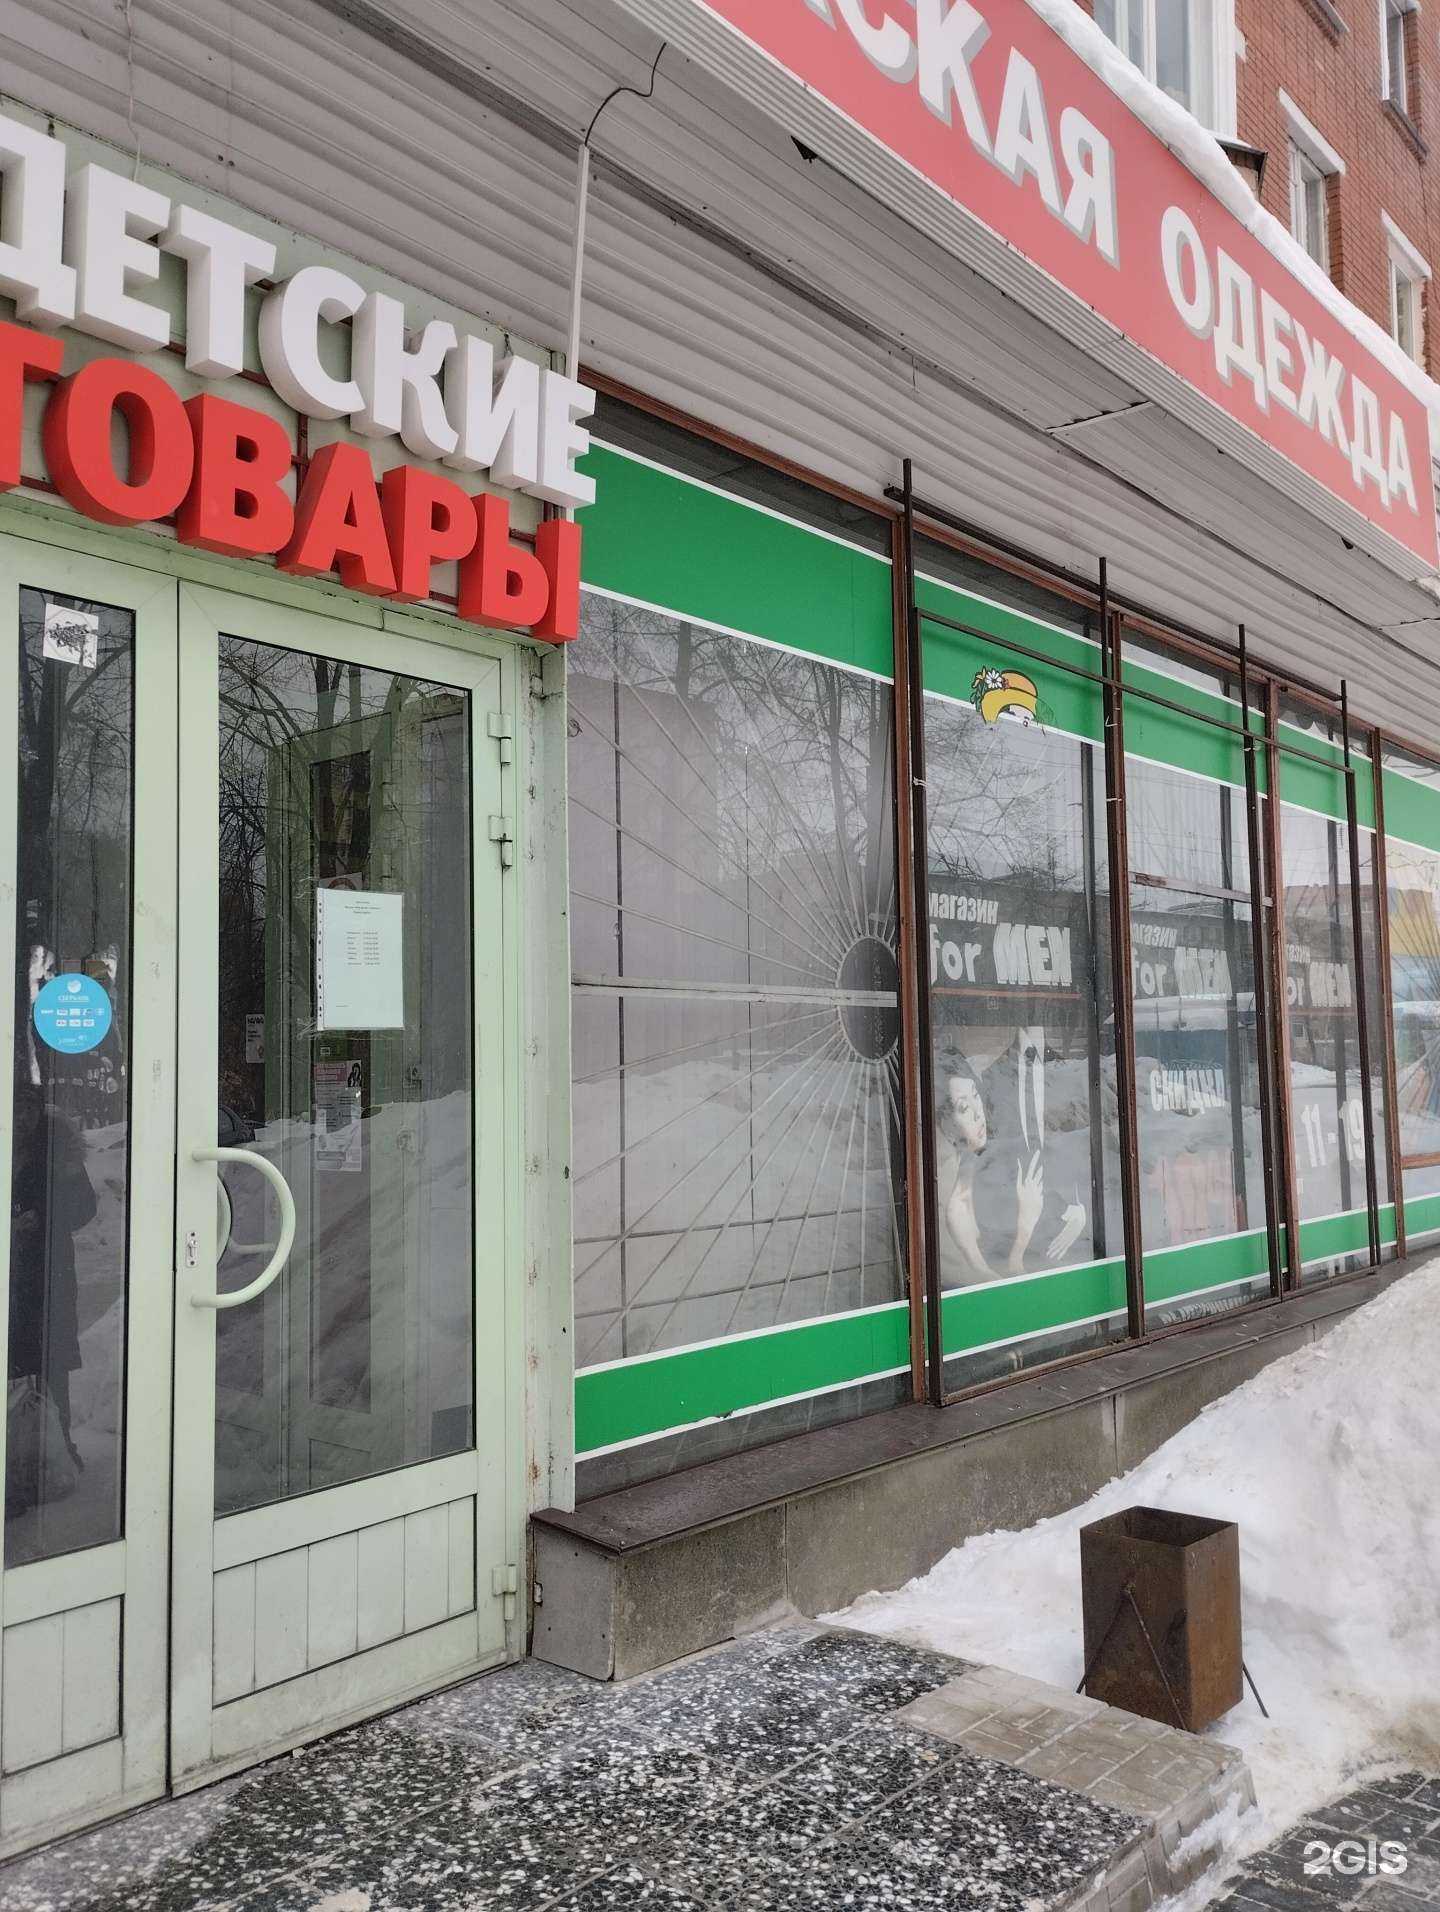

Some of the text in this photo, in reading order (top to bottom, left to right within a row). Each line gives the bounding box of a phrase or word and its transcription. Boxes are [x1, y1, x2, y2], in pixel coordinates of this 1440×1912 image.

[0, 114, 596, 508] ДЕТСКИЕ
[1161, 205, 1418, 515] ОДЕЖДА
[0, 321, 582, 643] ТОВАРЫ
[993, 922, 1072, 986] MEN
[1286, 976, 1305, 1006] or
